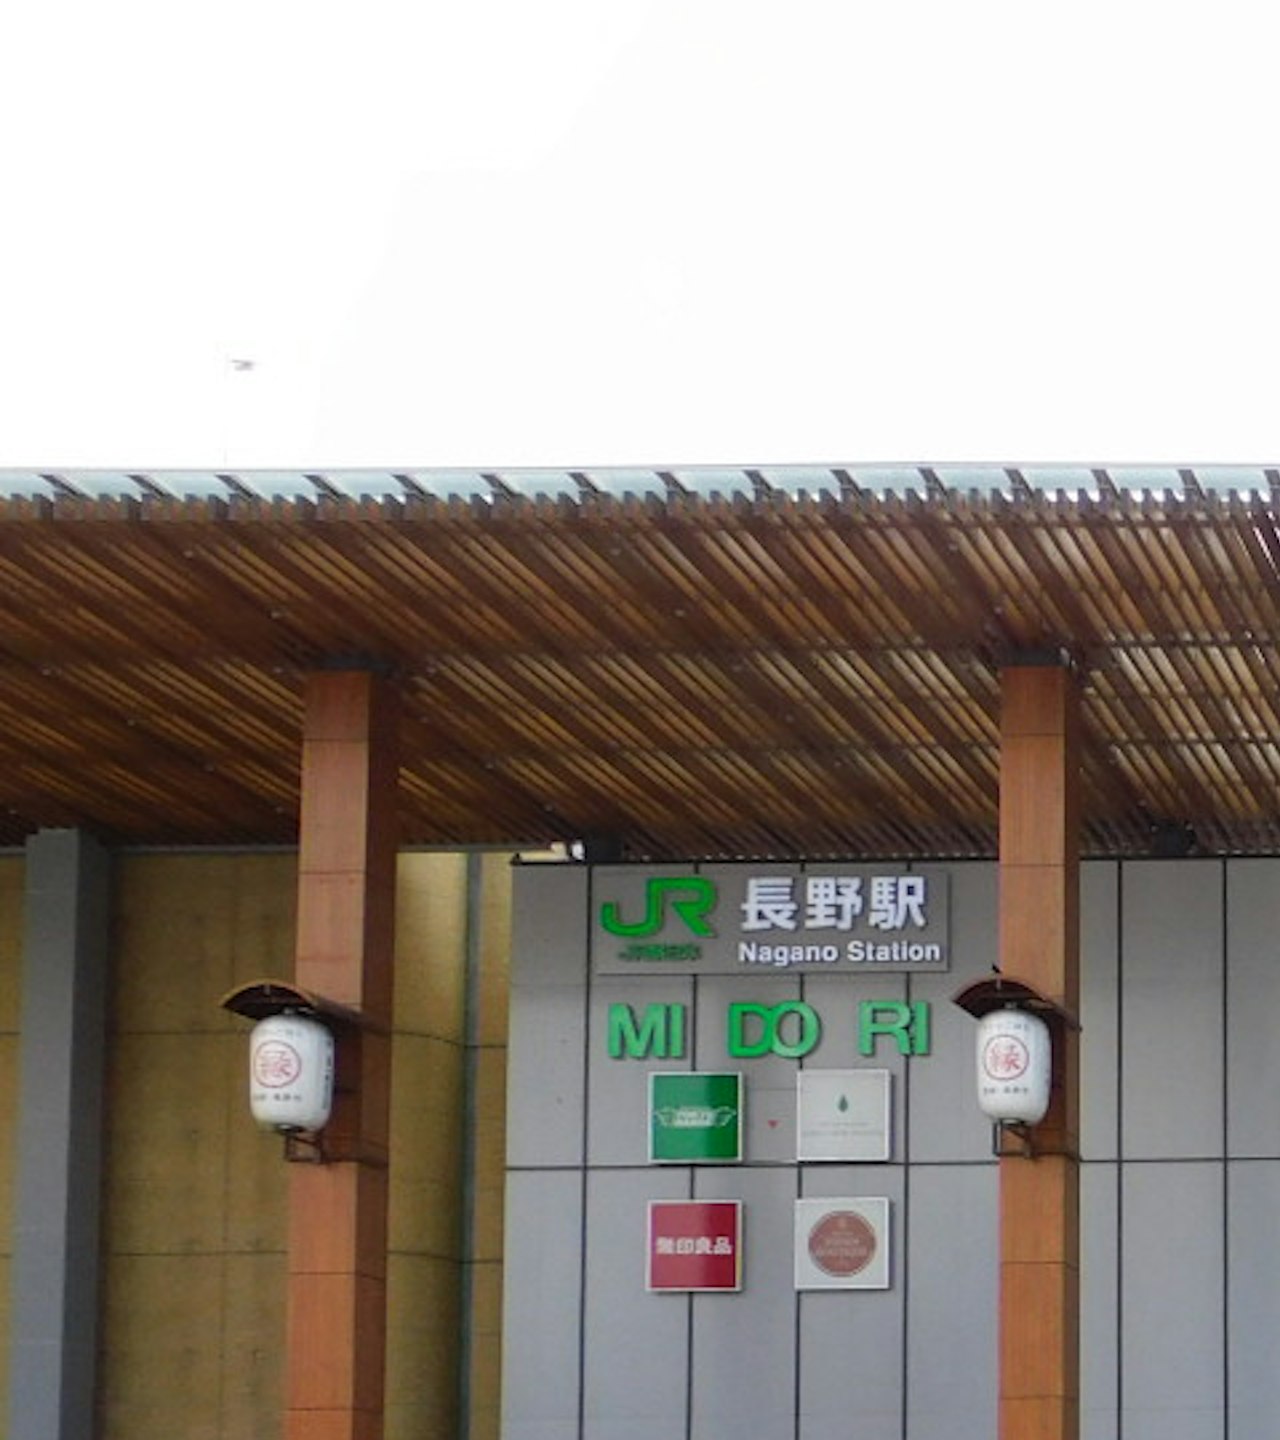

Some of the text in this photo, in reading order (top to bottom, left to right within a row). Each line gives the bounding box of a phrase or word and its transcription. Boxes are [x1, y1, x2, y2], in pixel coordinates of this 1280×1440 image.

[601, 876, 717, 938] JR
[740, 876, 927, 931] 長野駅
[738, 940, 940, 967] Nagano Station
[656, 1235, 733, 1255] 無印良品
